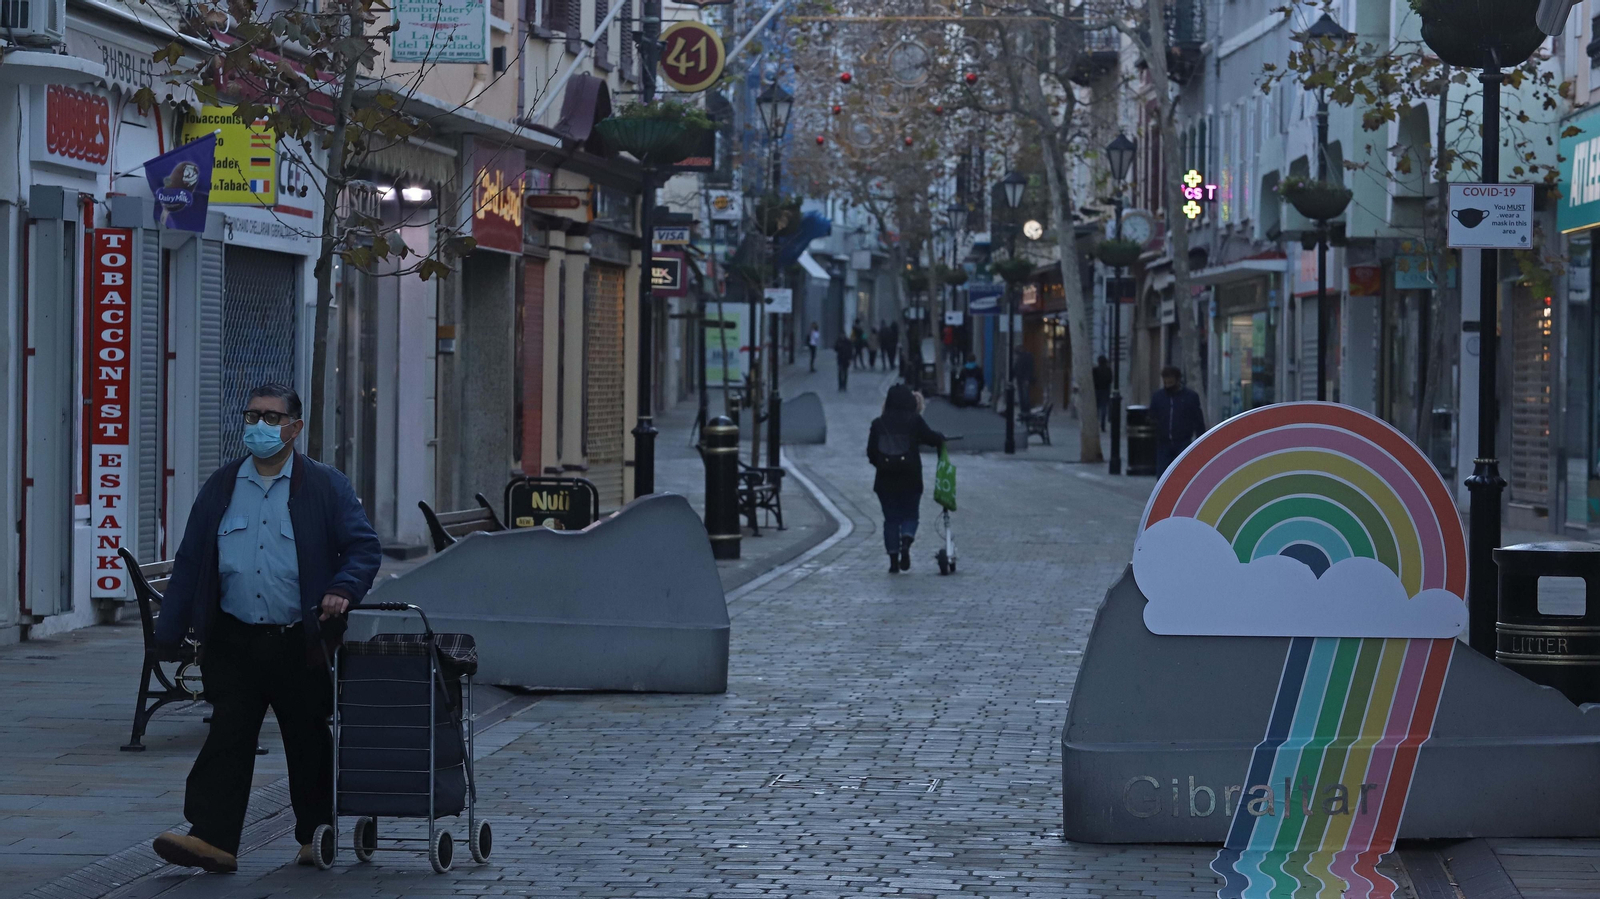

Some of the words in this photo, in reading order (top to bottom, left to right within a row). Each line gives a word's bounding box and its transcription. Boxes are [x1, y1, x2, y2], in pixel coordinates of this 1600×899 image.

[399, 4, 473, 15] Embroidery
[421, 13, 459, 22] House
[412, 31, 428, 40] La
[435, 31, 468, 40] Csa
[398, 40, 418, 48] del
[666, 36, 708, 76] 41
[102, 45, 153, 88] BUBBLES
[47, 84, 109, 166] BUBBLES
[219, 179, 248, 191] Tabac
[1463, 187, 1516, 197] COVID-19
[158, 193, 175, 203] Dairy
[175, 192, 190, 203] Milk
[658, 231, 685, 240] VISA
[98, 234, 127, 437] TOBACCONIST
[532, 490, 570, 511] Nuii
[97, 454, 122, 590] ESTANKO
[1512, 636, 1568, 653] LITTER
[1123, 775, 1377, 819] Gibraltar
